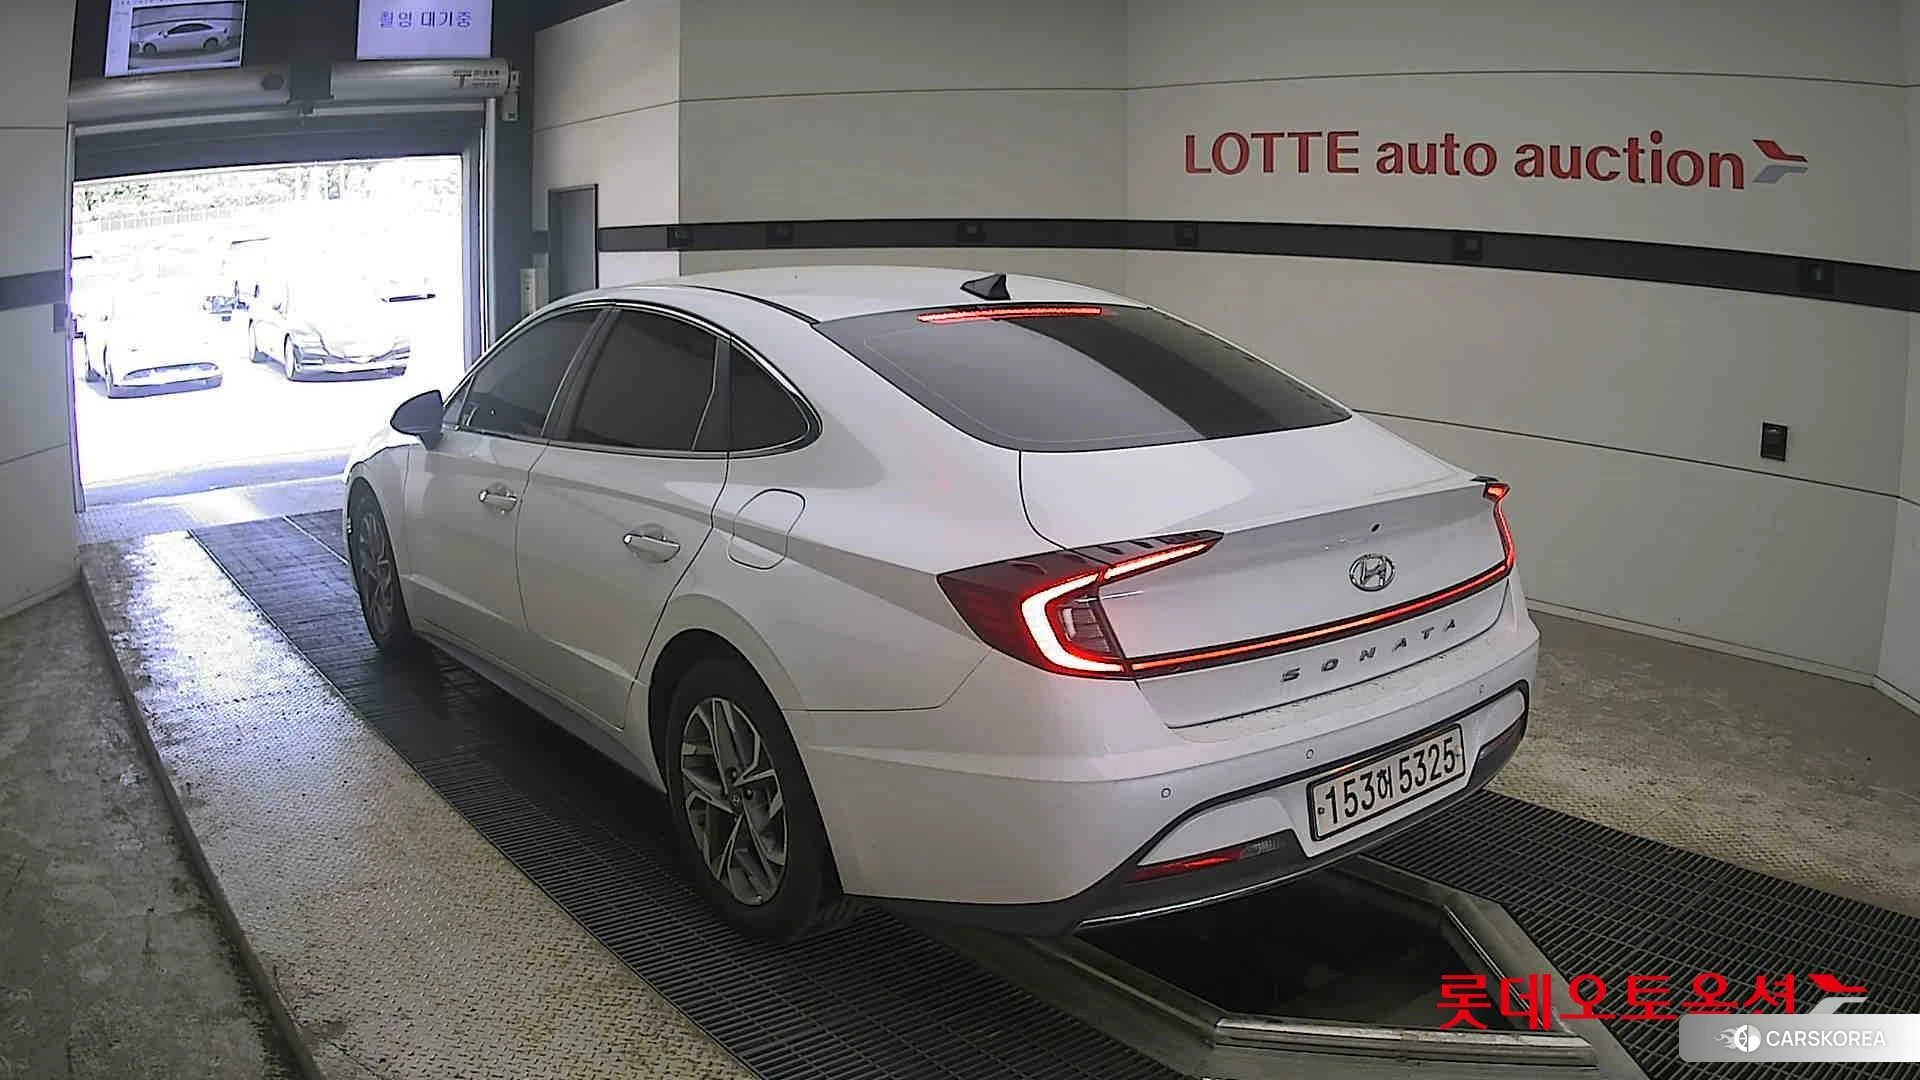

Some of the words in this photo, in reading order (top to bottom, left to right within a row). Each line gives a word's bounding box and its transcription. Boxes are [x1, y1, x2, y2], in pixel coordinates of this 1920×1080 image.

[420, 11, 473, 29] 대기중
[1184, 130, 1359, 174] LOTTE
[1375, 133, 1498, 178] auto
[1513, 130, 1746, 190] auction
[1280, 618, 1456, 682] SONATA
[1399, 737, 1456, 793] 5325
